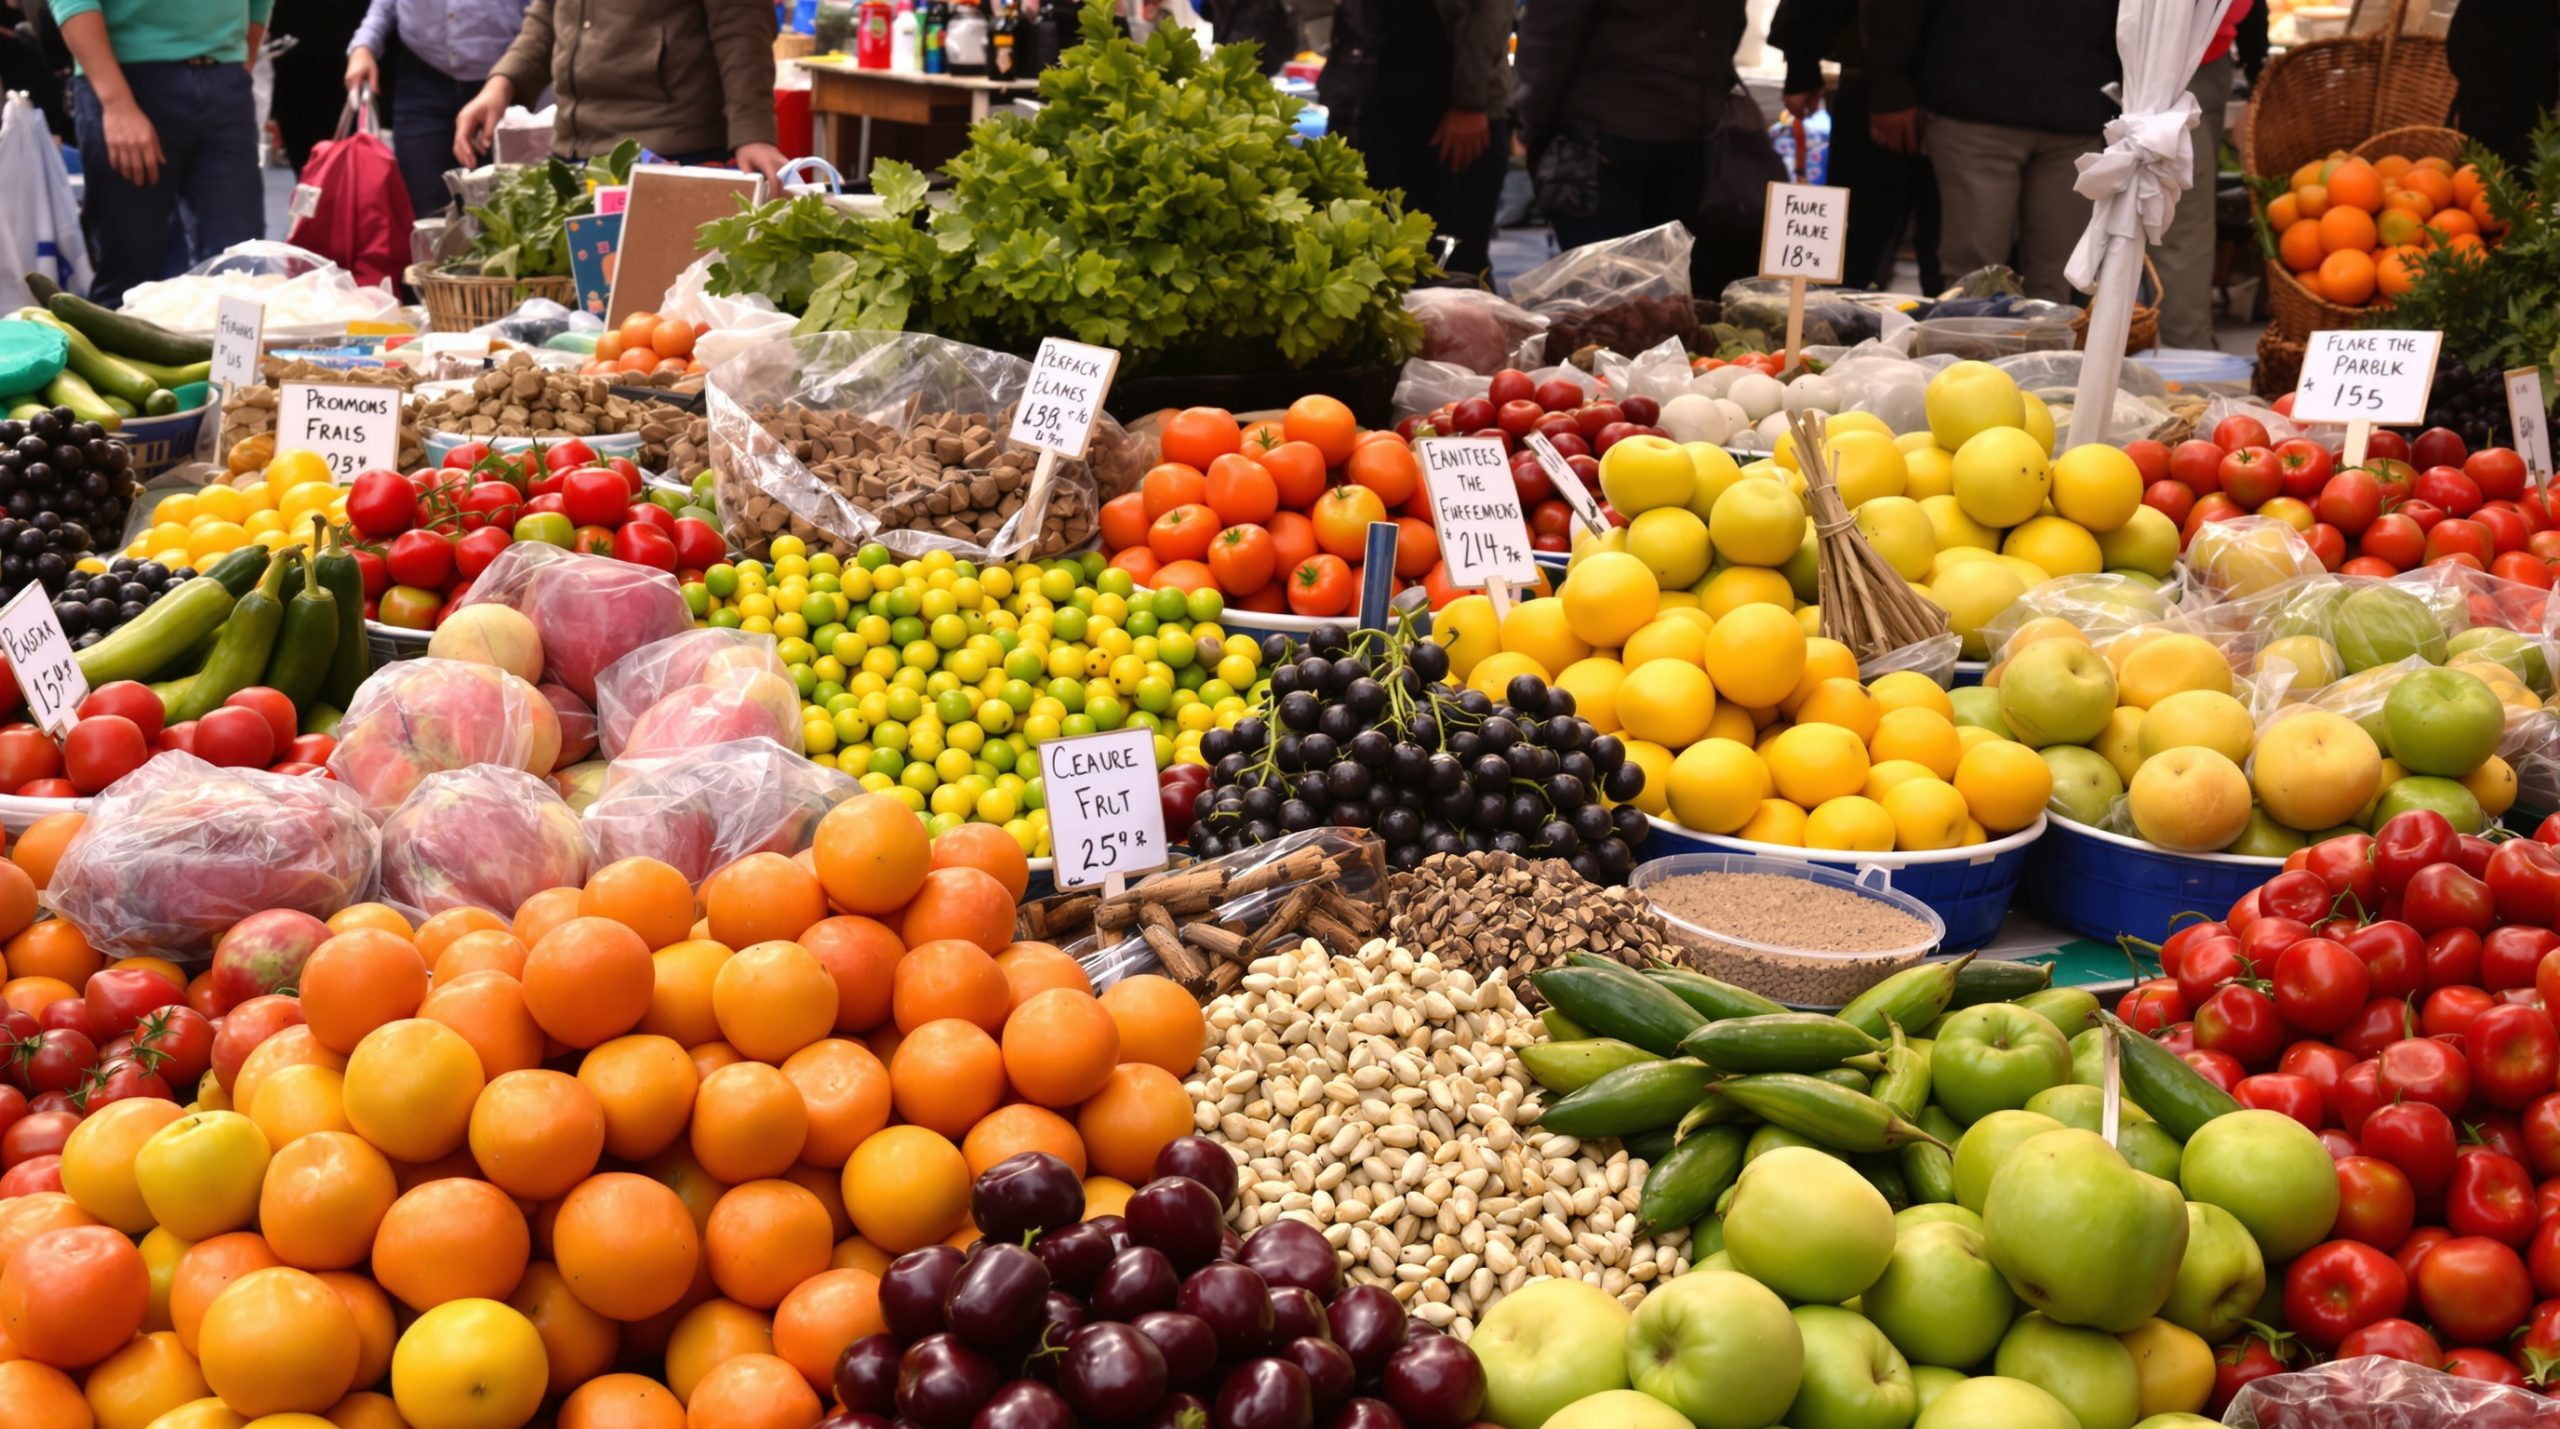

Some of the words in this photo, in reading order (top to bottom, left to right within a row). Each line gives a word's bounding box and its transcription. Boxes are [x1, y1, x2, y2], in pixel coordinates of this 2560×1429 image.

[2327, 335, 2378, 352] FLAKE
[2387, 338, 2417, 353] THE
[2334, 384, 2384, 410] 155
[1457, 474, 1486, 493] THE
[1459, 531, 1499, 569] 214
